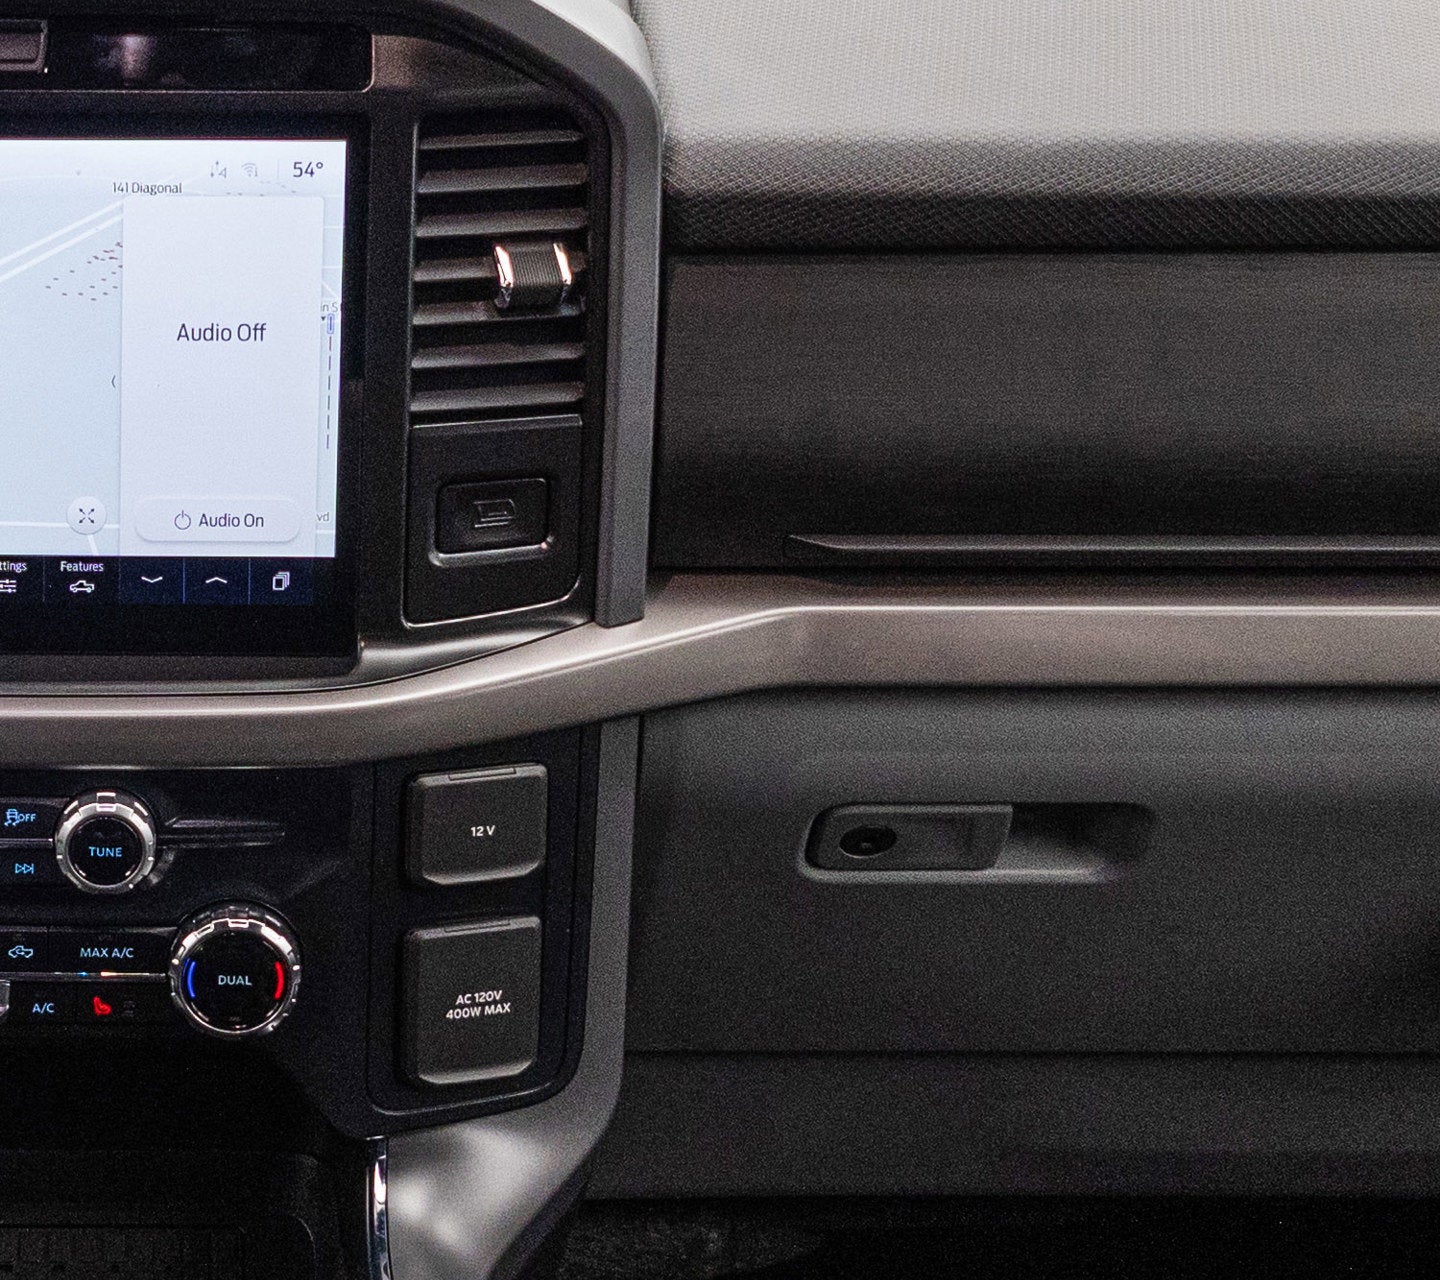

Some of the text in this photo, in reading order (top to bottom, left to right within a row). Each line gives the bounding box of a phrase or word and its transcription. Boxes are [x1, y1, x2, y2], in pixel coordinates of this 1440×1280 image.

[292, 161, 324, 178] 54°
[112, 181, 182, 196] 141 Diagonal
[177, 322, 266, 342] Audio Off
[198, 513, 265, 528] Audio On
[60, 561, 104, 572] Features
[19, 812, 37, 822] OFF
[470, 825, 496, 837] 12 V
[88, 846, 123, 858] TUNE
[80, 947, 134, 959] MAX A/C
[217, 974, 252, 986] DUAL
[456, 989, 503, 1005] AC 120V
[32, 1002, 55, 1014] A/C
[446, 1002, 511, 1019] 400W MAX
